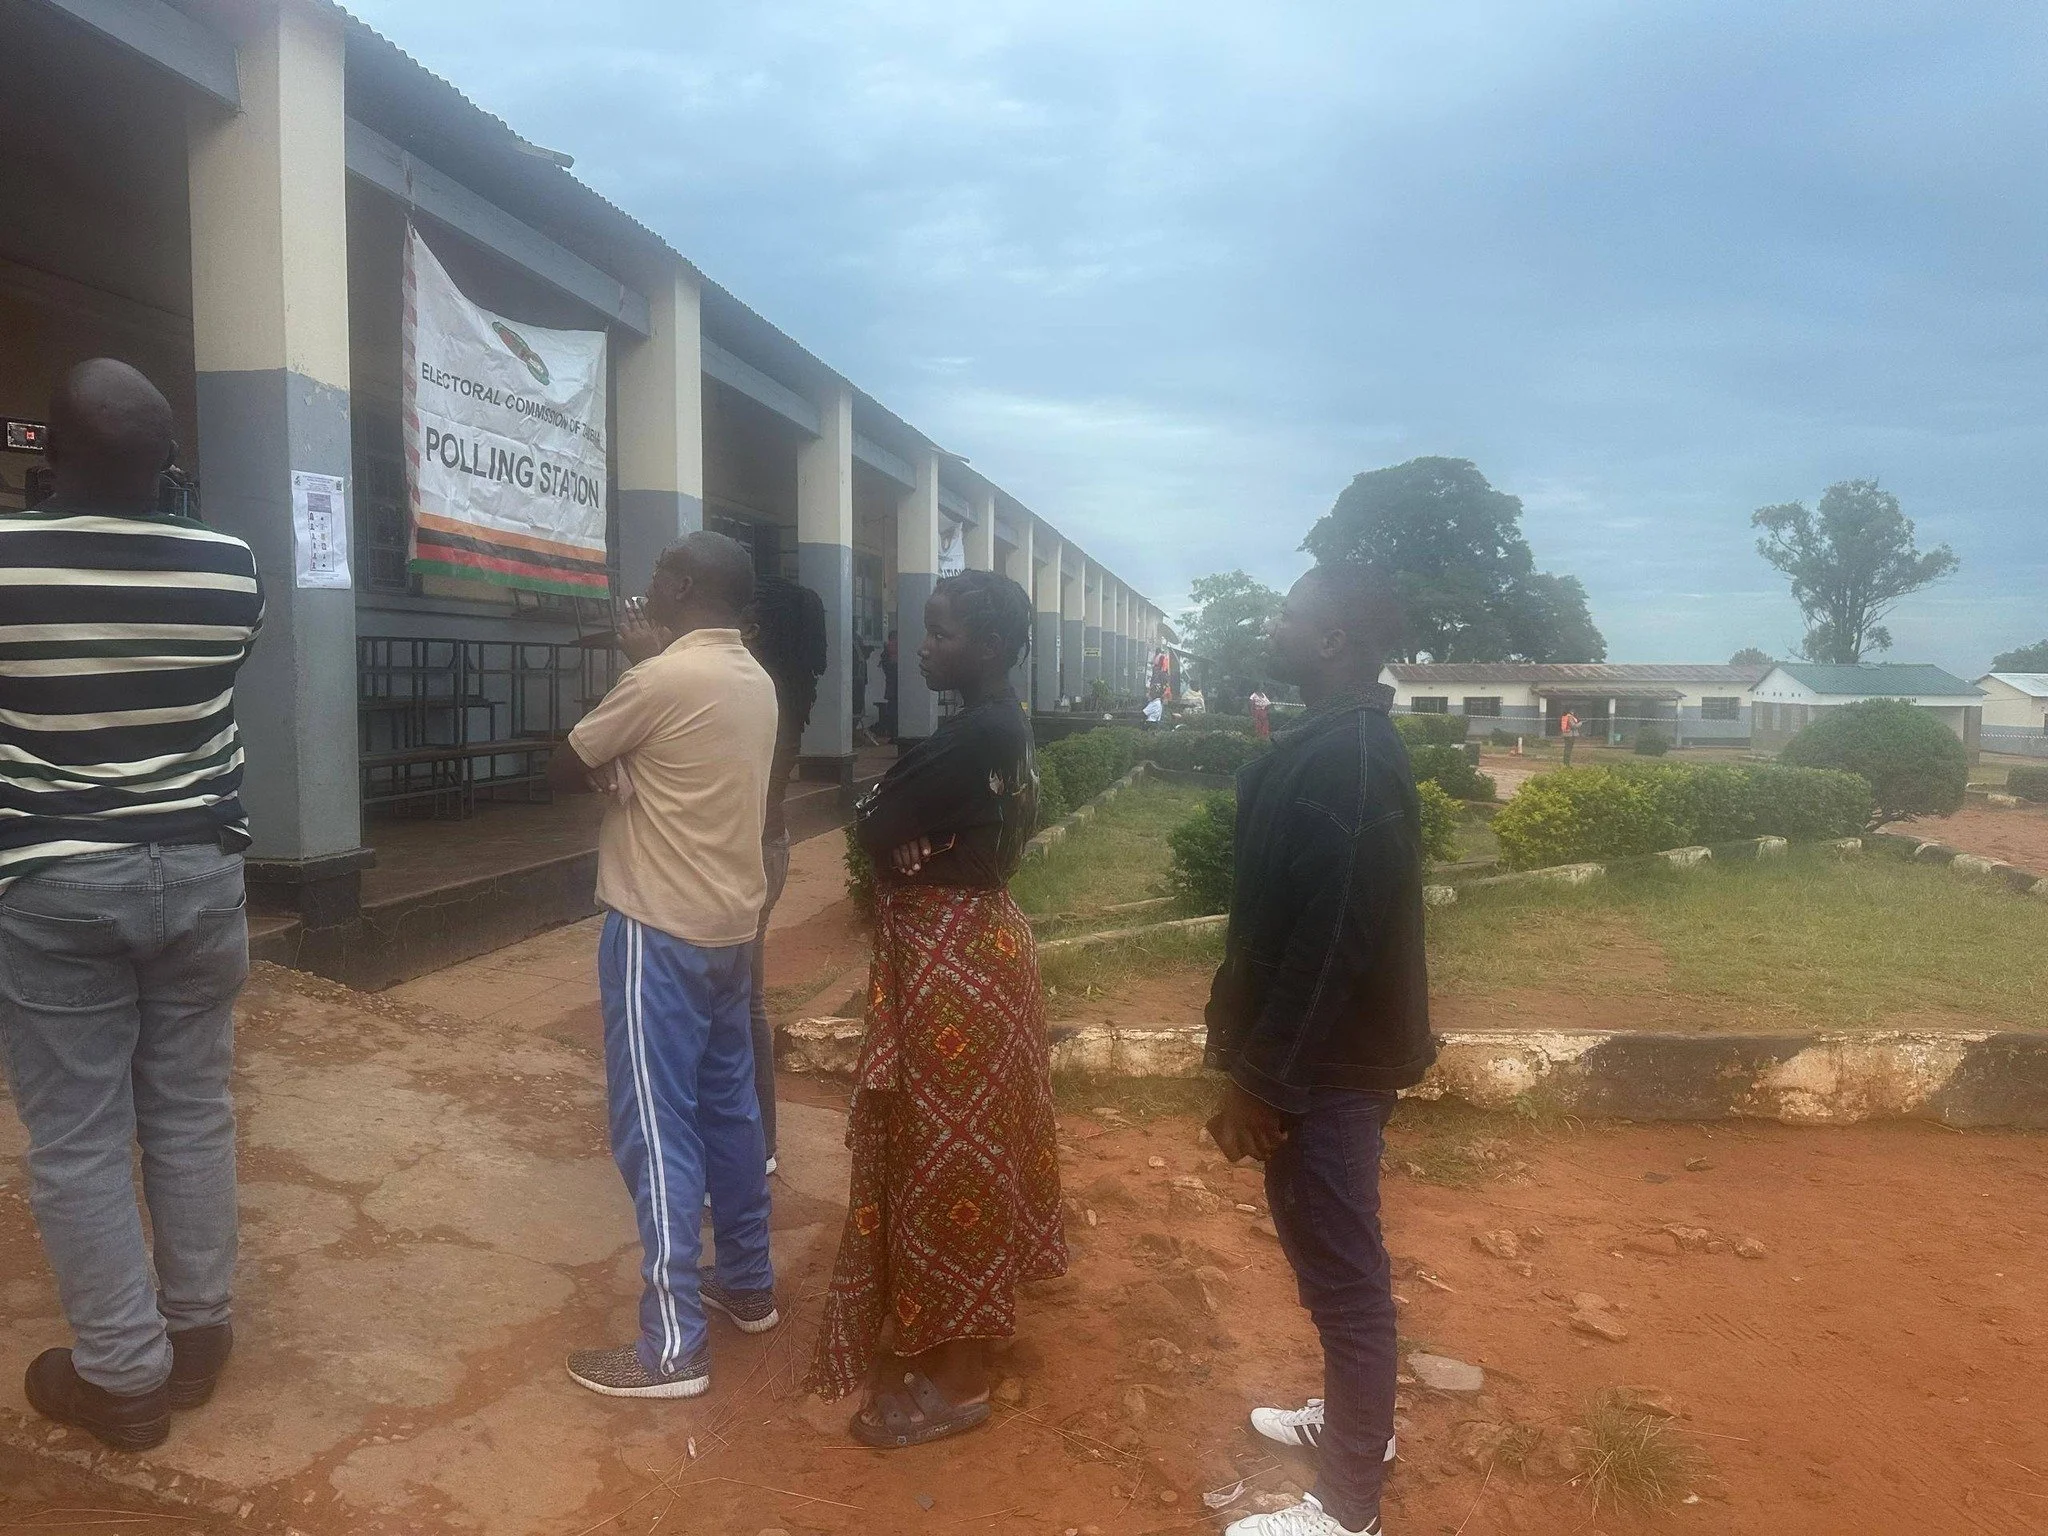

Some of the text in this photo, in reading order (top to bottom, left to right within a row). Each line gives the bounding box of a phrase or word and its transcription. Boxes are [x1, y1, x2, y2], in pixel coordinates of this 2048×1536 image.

[422, 362, 500, 406] ELECTORAL
[505, 394, 568, 430] COMMISSION
[569, 419, 580, 434] OF
[426, 426, 599, 508] POLLING STATION
